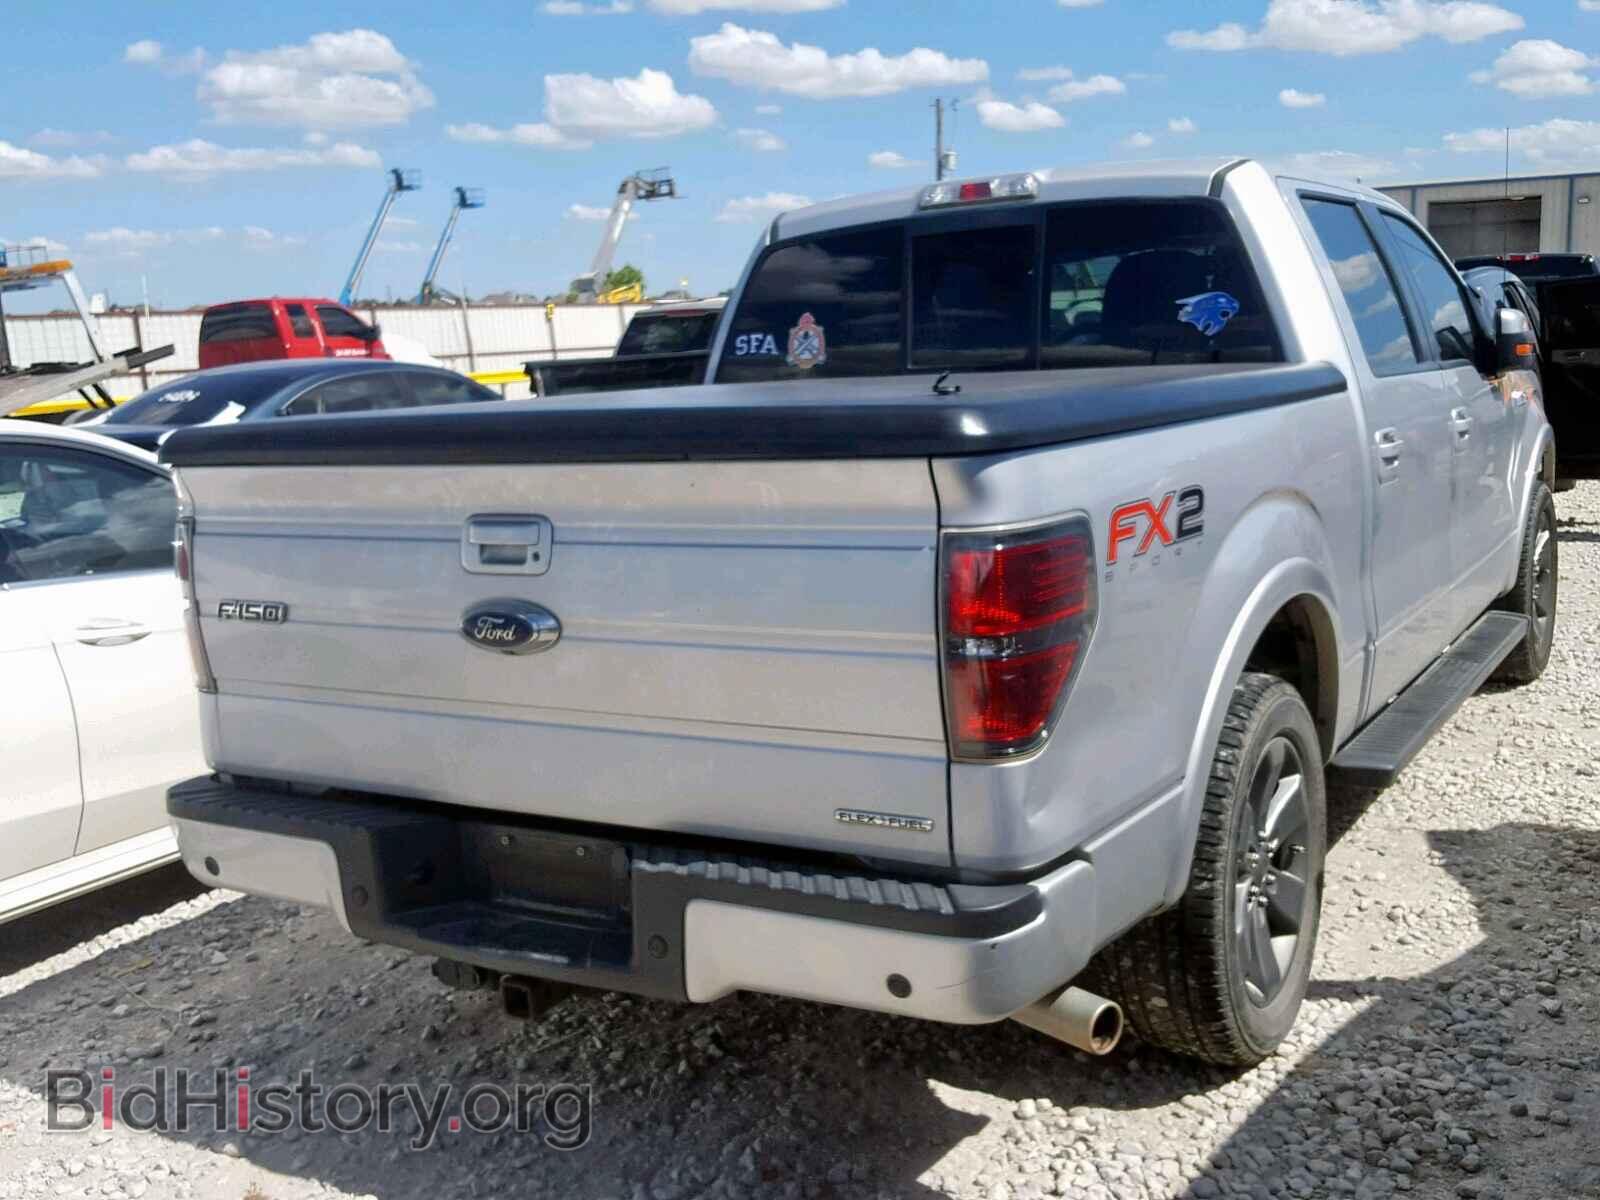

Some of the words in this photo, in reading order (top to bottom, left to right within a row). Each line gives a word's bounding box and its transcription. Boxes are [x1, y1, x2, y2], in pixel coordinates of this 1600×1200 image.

[735, 333, 779, 356] SFA
[1105, 484, 1205, 568] FX2
[473, 615, 515, 641] Ford
